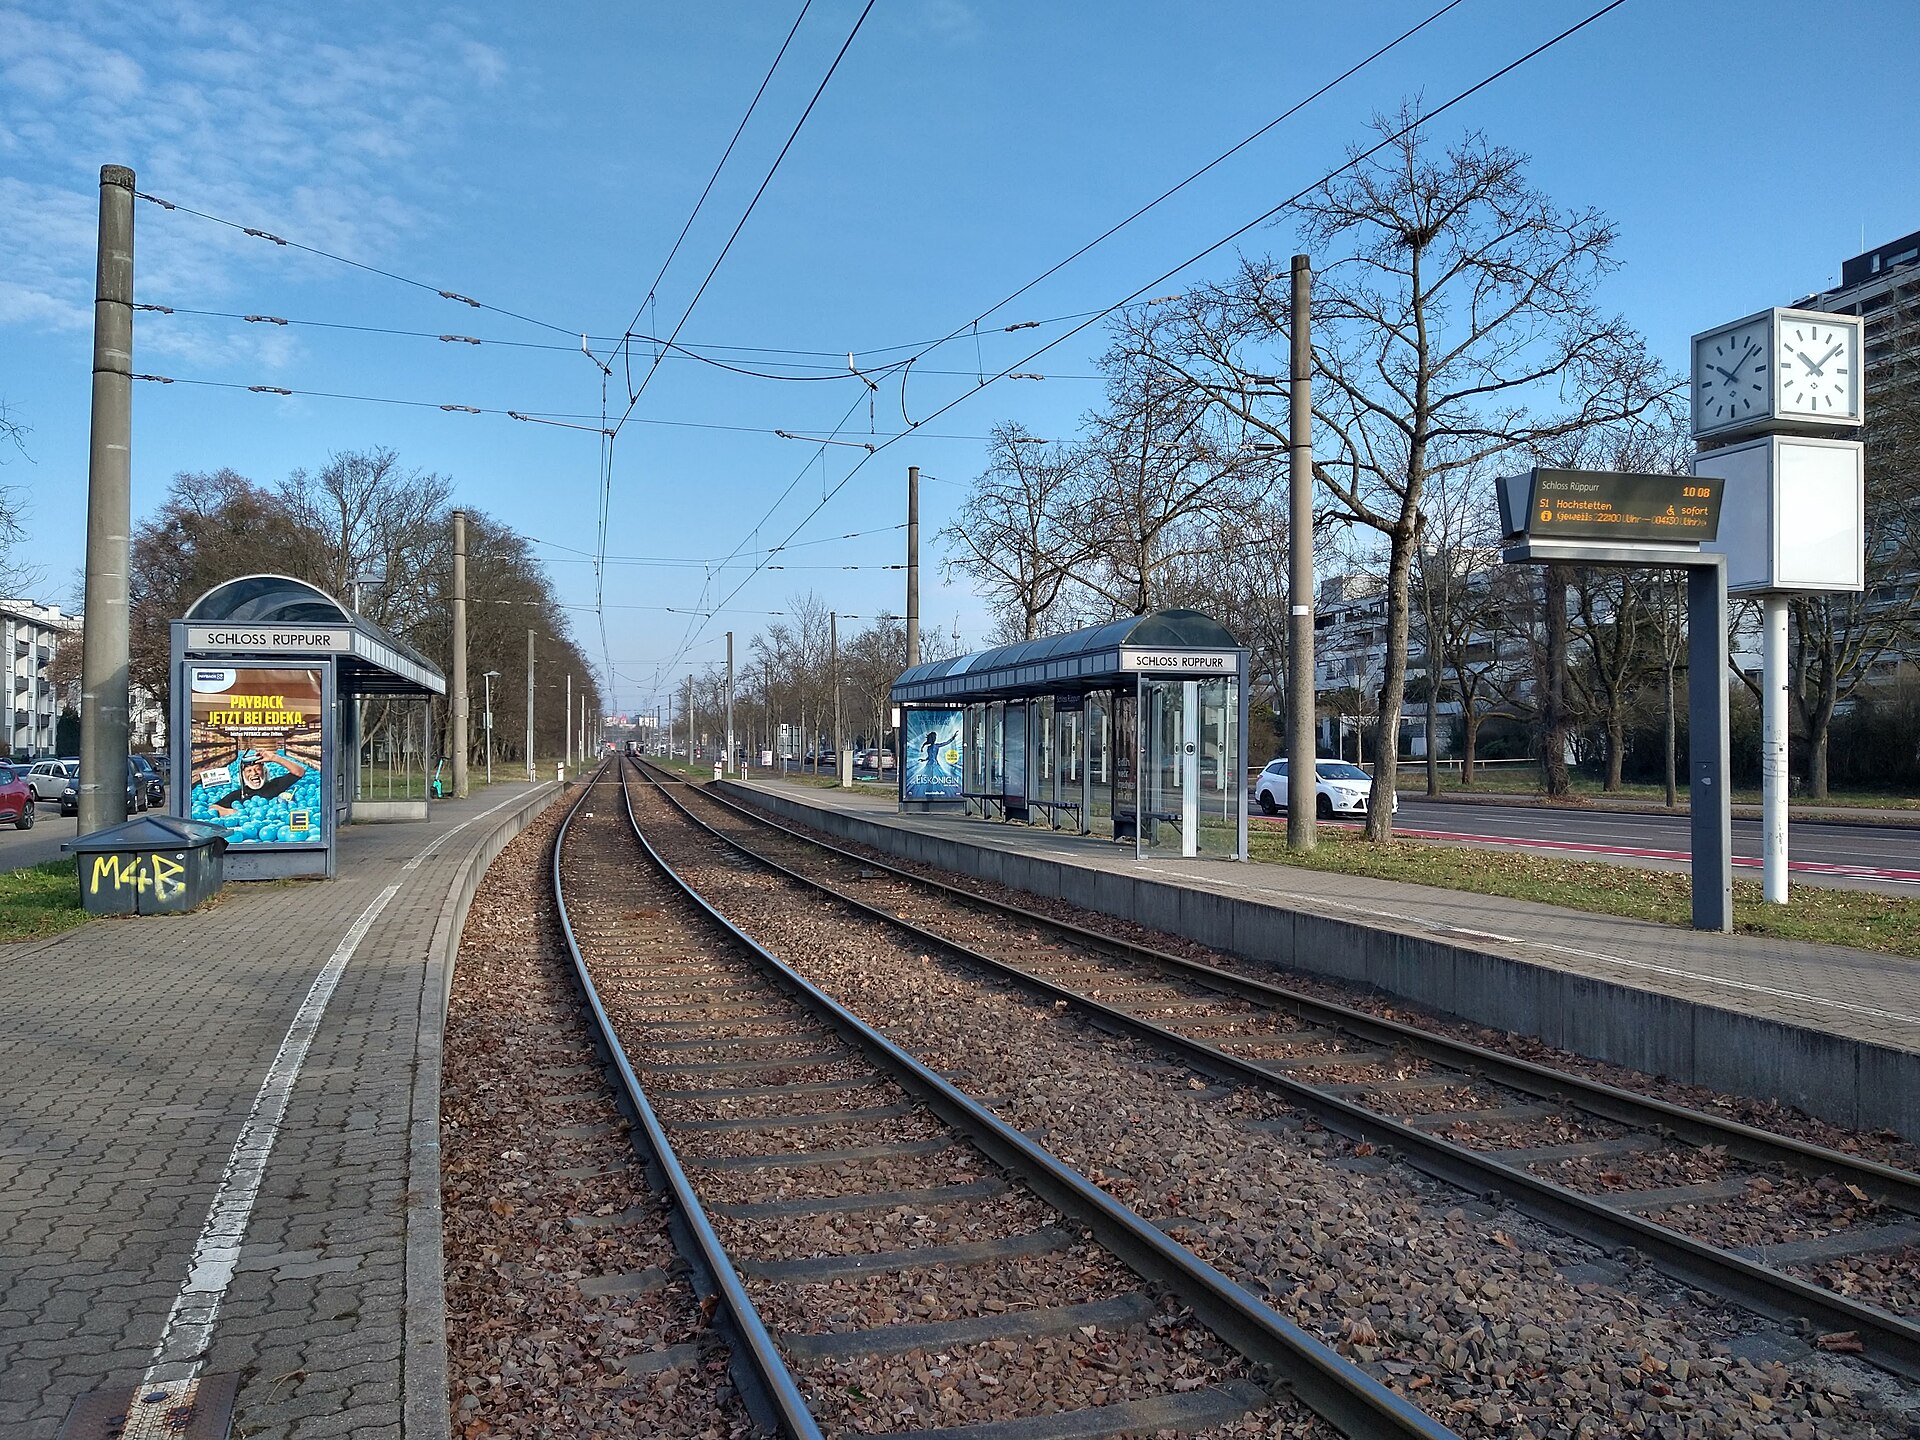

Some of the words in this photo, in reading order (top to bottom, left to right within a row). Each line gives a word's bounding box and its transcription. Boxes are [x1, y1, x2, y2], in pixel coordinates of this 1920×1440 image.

[1542, 481, 1568, 490] Schloss
[1570, 482, 1599, 492] Rüppurr
[1539, 498, 1549, 508] S1
[1556, 499, 1612, 510] Hochstetten
[1681, 506, 1708, 516] sofort
[207, 633, 266, 645] SCHLOSS
[272, 634, 331, 646] RÜPPURR
[1136, 656, 1178, 667] SCHLOSS
[1181, 657, 1224, 668] RÜPPURR
[230, 695, 284, 709] PAYBACK
[208, 711, 241, 725] JETZT
[243, 711, 262, 725] BEI
[265, 711, 306, 726] EDEKA.
[782, 725, 788, 734] H
